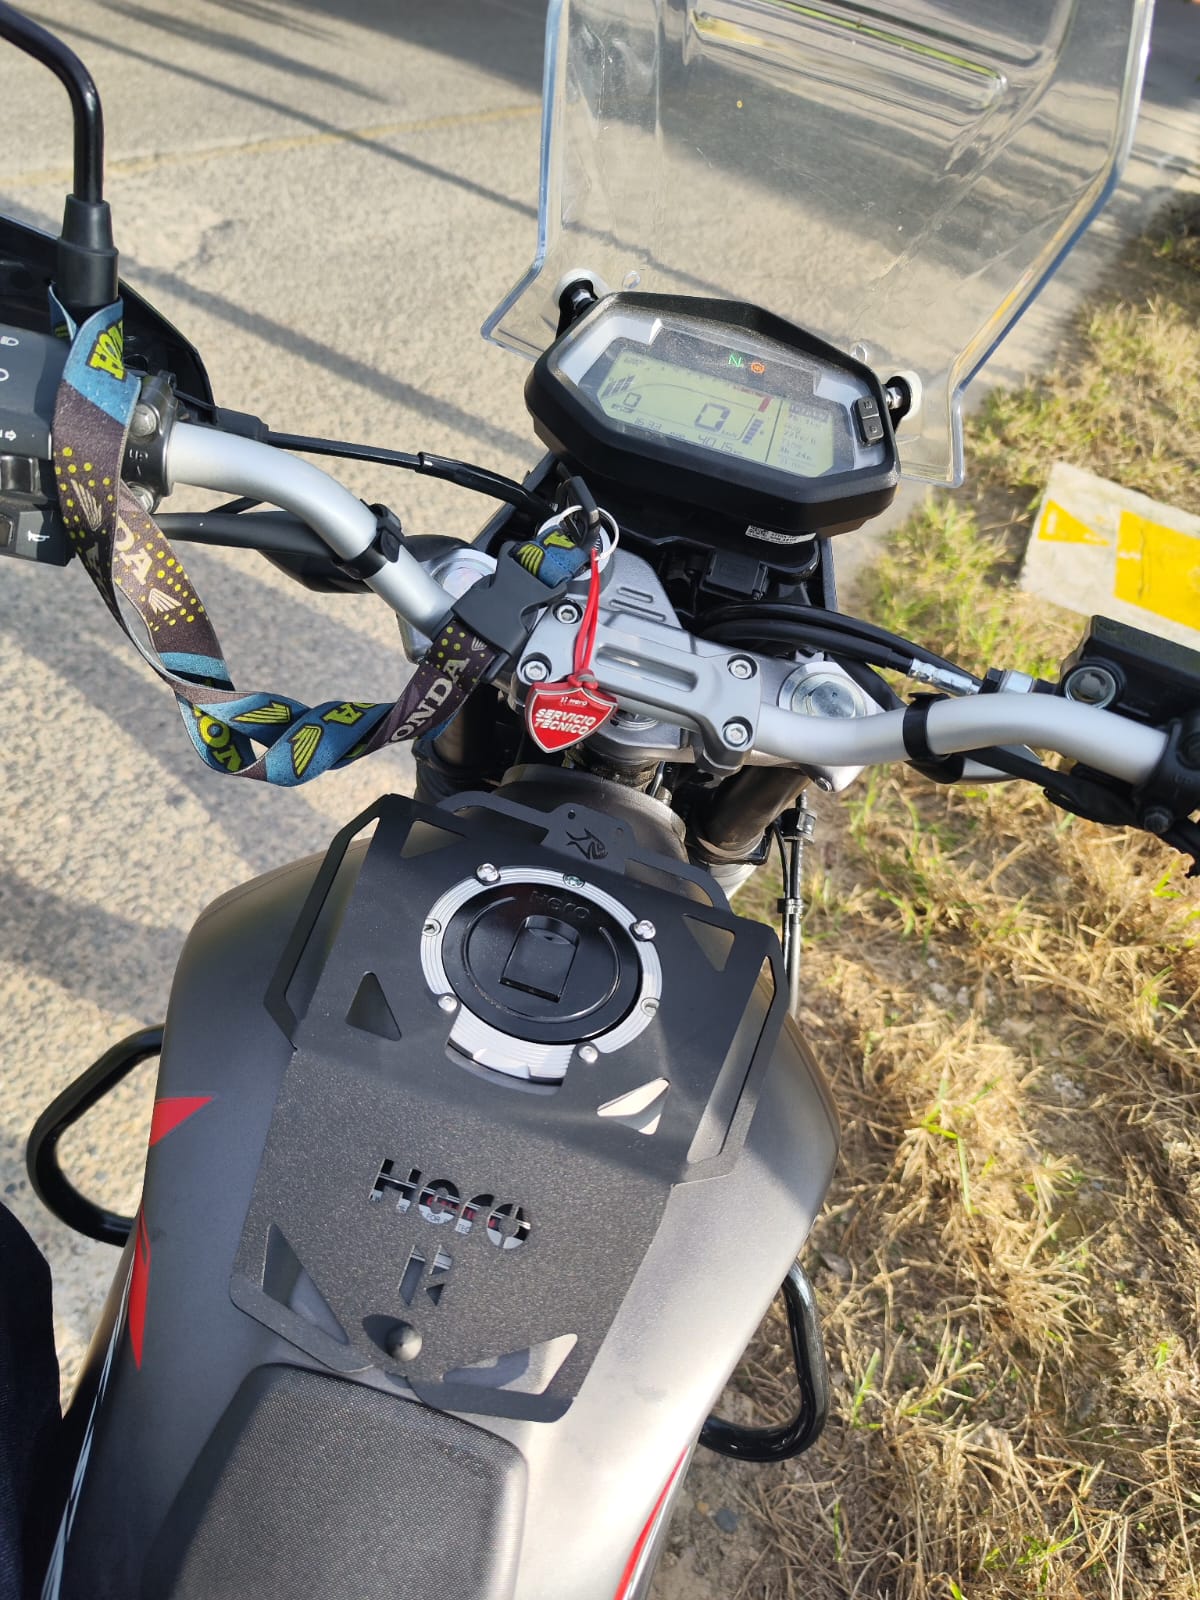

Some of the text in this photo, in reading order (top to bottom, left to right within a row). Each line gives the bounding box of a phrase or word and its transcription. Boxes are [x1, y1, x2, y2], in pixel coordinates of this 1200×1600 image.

[728, 353, 744, 368] N
[694, 402, 731, 432] 0
[535, 708, 597, 727] SERVICIO
[369, 1157, 532, 1250] Hero
